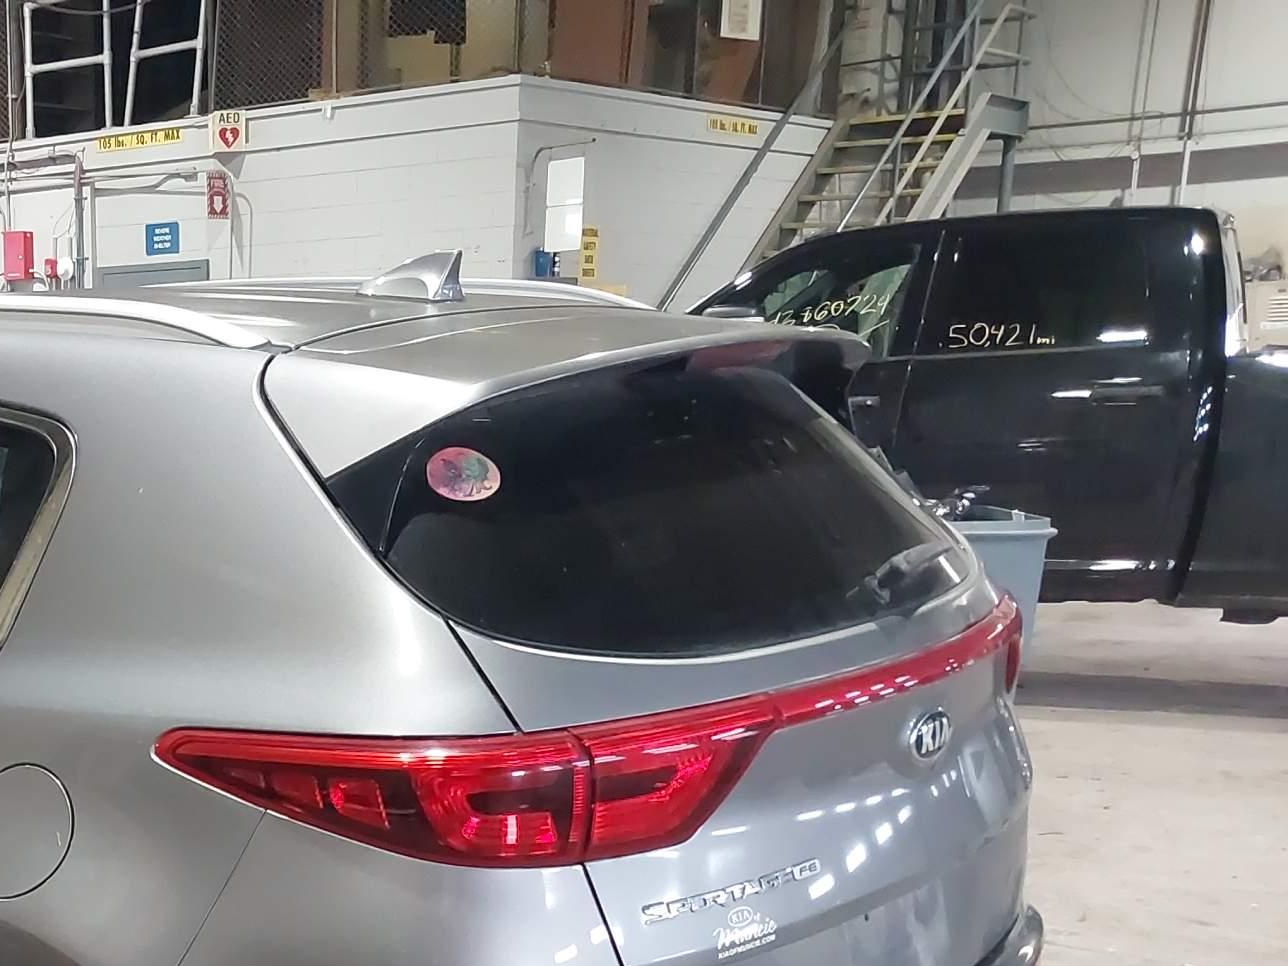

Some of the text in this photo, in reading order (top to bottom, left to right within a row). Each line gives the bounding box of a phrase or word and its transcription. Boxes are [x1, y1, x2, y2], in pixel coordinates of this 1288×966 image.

[219, 112, 240, 124] AED
[98, 139, 112, 150] 105
[114, 137, 127, 148] lbs.
[136, 134, 148, 146] SQ.
[150, 133, 161, 144] FT.
[164, 128, 180, 141] MAX
